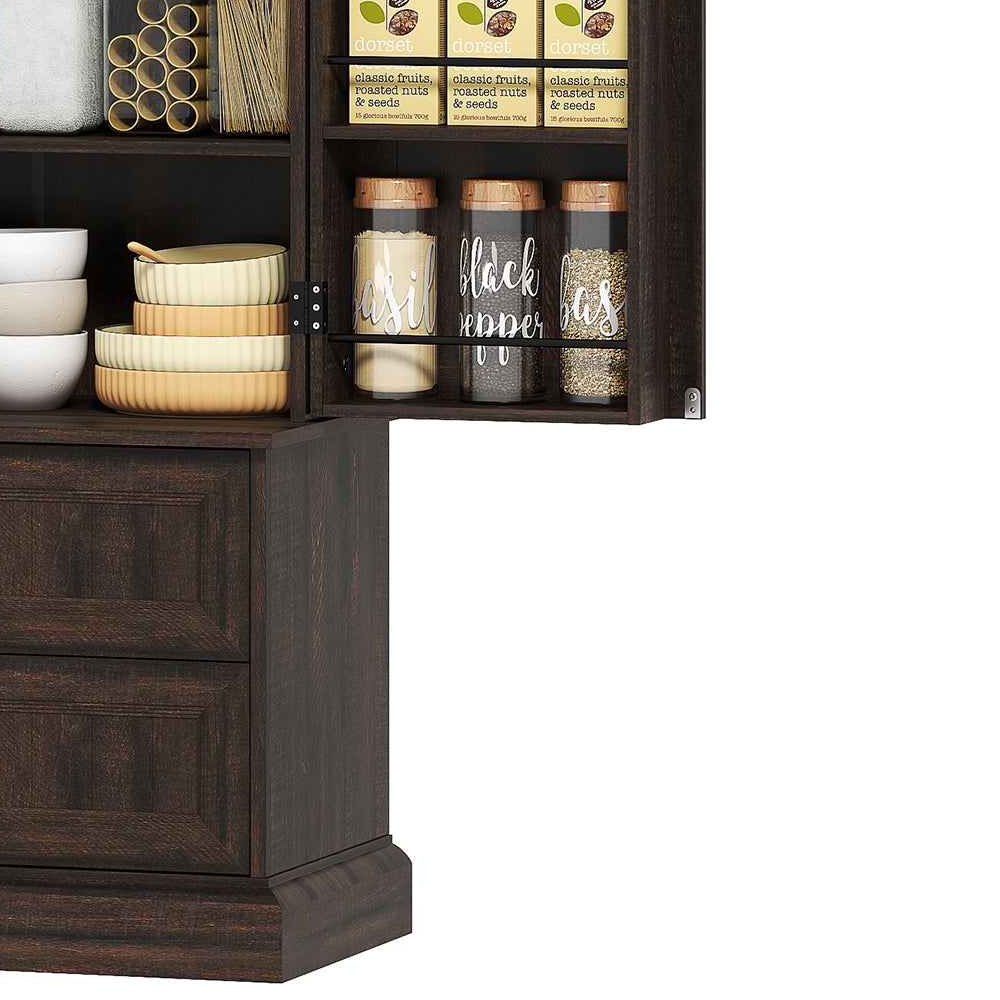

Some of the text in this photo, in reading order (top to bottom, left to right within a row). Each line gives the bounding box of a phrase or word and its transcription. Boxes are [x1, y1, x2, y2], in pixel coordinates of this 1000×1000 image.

[354, 36, 413, 52] dorset
[452, 38, 511, 53] dorset
[549, 39, 609, 55] dorset
[355, 73, 432, 85] classic fruits,
[453, 74, 531, 86] classic fruits,
[550, 76, 590, 85] classic
[355, 86, 429, 95] roasted nuts
[453, 87, 527, 97] roasted nuts
[550, 89, 625, 98] roasted nuts
[355, 97, 400, 107] & seeds
[453, 98, 498, 108] & seeds
[550, 100, 596, 110] & seeds
[460, 236, 540, 299] black
